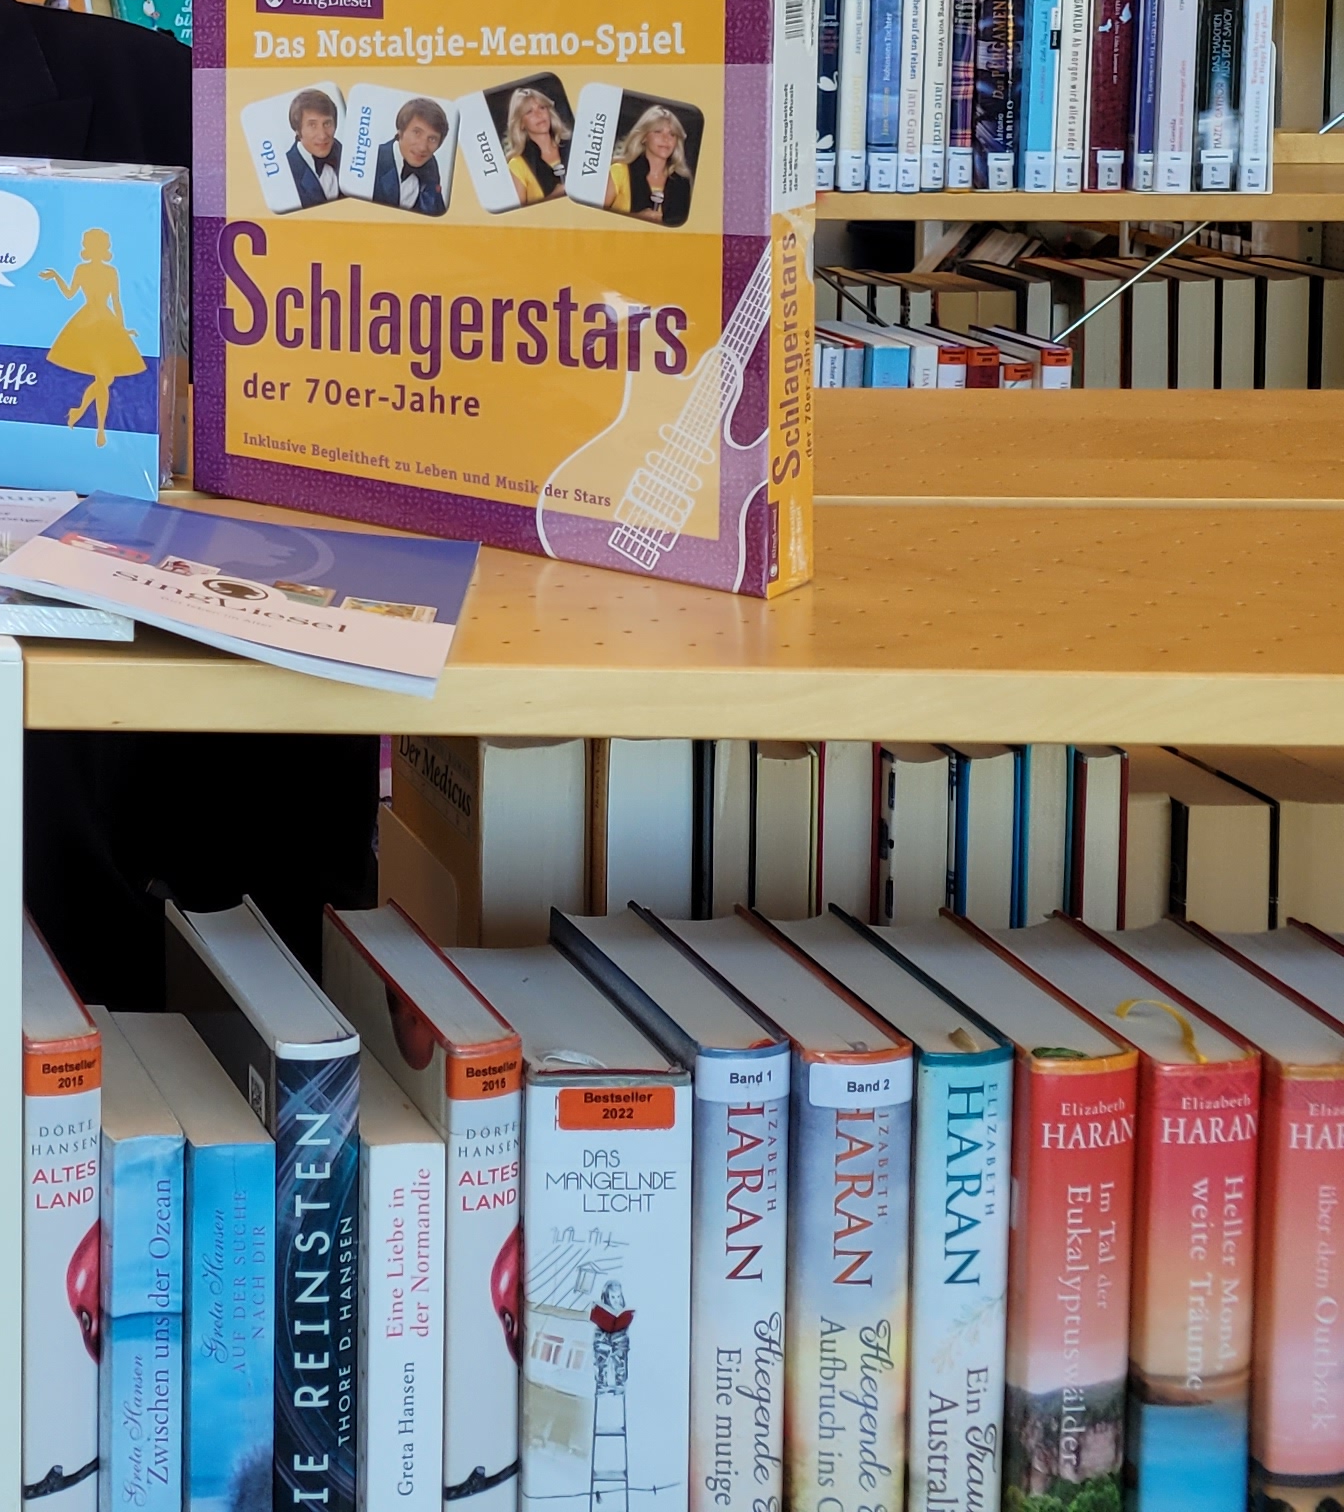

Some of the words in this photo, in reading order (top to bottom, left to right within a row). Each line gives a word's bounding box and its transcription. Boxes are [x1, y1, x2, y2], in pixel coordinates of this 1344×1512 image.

[254, 30, 306, 59] Das
[317, 23, 686, 64] Nostalgie-Memo-Spiel
[264, 140, 281, 177] Udo
[349, 105, 373, 179] Jürgens
[481, 131, 498, 176] Lena
[582, 112, 608, 178] Valaitis
[217, 221, 689, 379] Schlagerstars
[772, 233, 801, 486] Schlagerstars
[243, 373, 292, 401] der
[305, 378, 481, 419] 70er-Jahre
[243, 433, 306, 455] Inklusive
[311, 442, 391, 472] Begleitheft
[395, 458, 411, 473] zu
[415, 460, 458, 481] Leben
[462, 467, 491, 485] und
[495, 473, 539, 495] Musik
[544, 481, 569, 499] der
[574, 487, 611, 507] Stars
[112, 570, 348, 633] SingLiesel
[583, 1091, 653, 1105] Bestseller
[602, 1106, 634, 1121] 2022
[1060, 1100, 1126, 1117] Elizabeth
[983, 1082, 998, 1217] ELIZABETH
[1041, 1114, 1135, 1151] HARAN
[31, 1160, 98, 1185] ALTES
[545, 1171, 677, 1191] MANGELNDE
[582, 1149, 621, 1169] DAS
[35, 1187, 95, 1211] LAND
[386, 1187, 405, 1219] in
[582, 1193, 655, 1213] LICHT
[943, 1081, 986, 1288] HARAN
[409, 1167, 432, 1292] Normandie
[293, 1112, 333, 1409] REINSTEN
[385, 1225, 405, 1287] Liebe
[385, 1292, 404, 1339] Eine
[409, 1298, 431, 1338] der
[1058, 1184, 1092, 1468] Eukalyptuswälder
